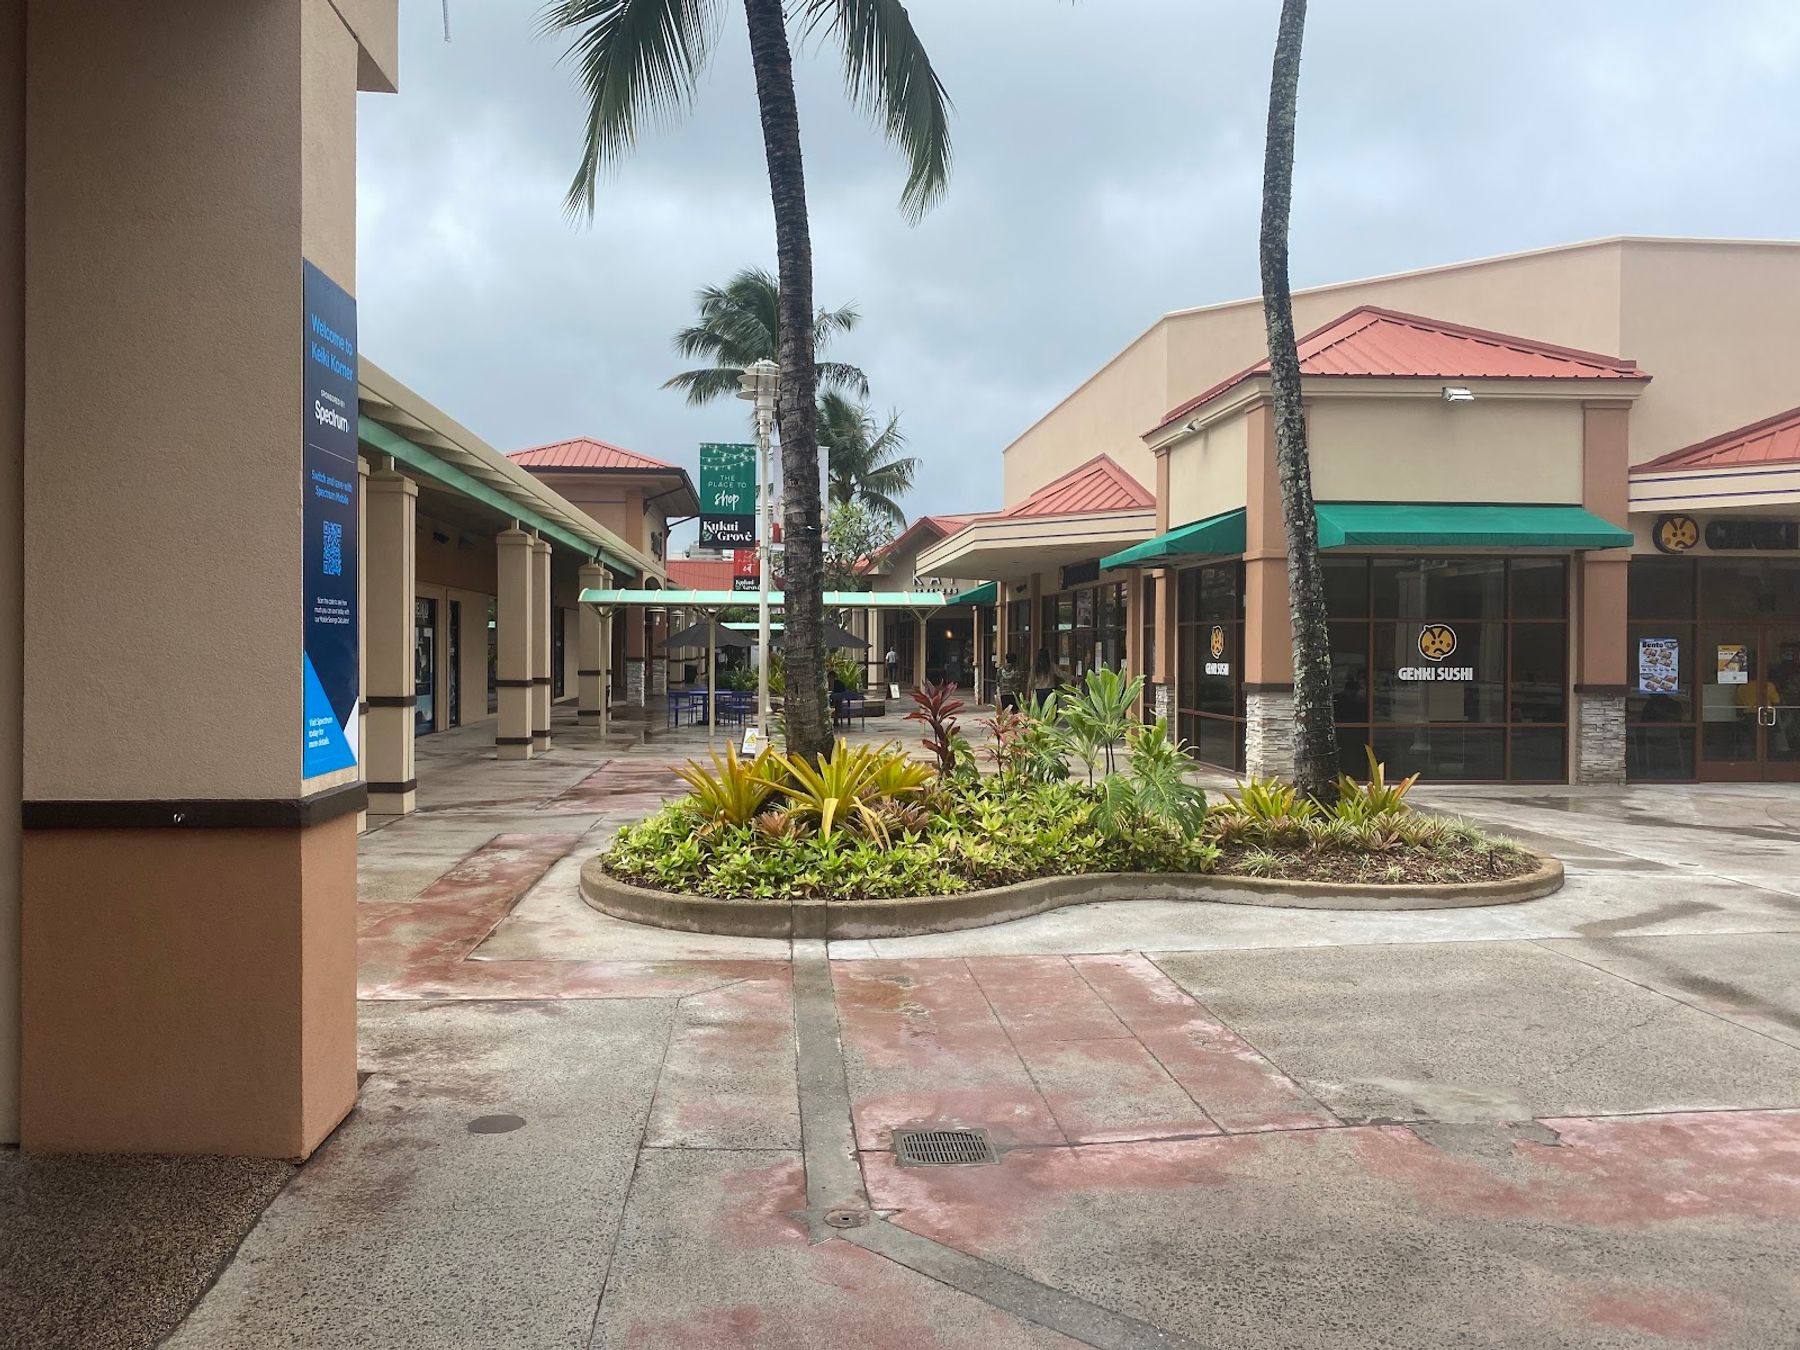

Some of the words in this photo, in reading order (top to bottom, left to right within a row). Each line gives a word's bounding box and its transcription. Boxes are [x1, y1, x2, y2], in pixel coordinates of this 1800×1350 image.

[311, 313, 345, 350] Welcome
[345, 337, 353, 356] to
[311, 341, 330, 368] Keiki
[330, 354, 354, 381] Korner
[315, 400, 348, 432] Spectrum
[714, 490, 740, 511] shop
[703, 521, 739, 534] Kukui
[717, 531, 753, 542] Grove
[1398, 667, 1436, 681] GENKI
[1436, 667, 1473, 681] SUSHI
